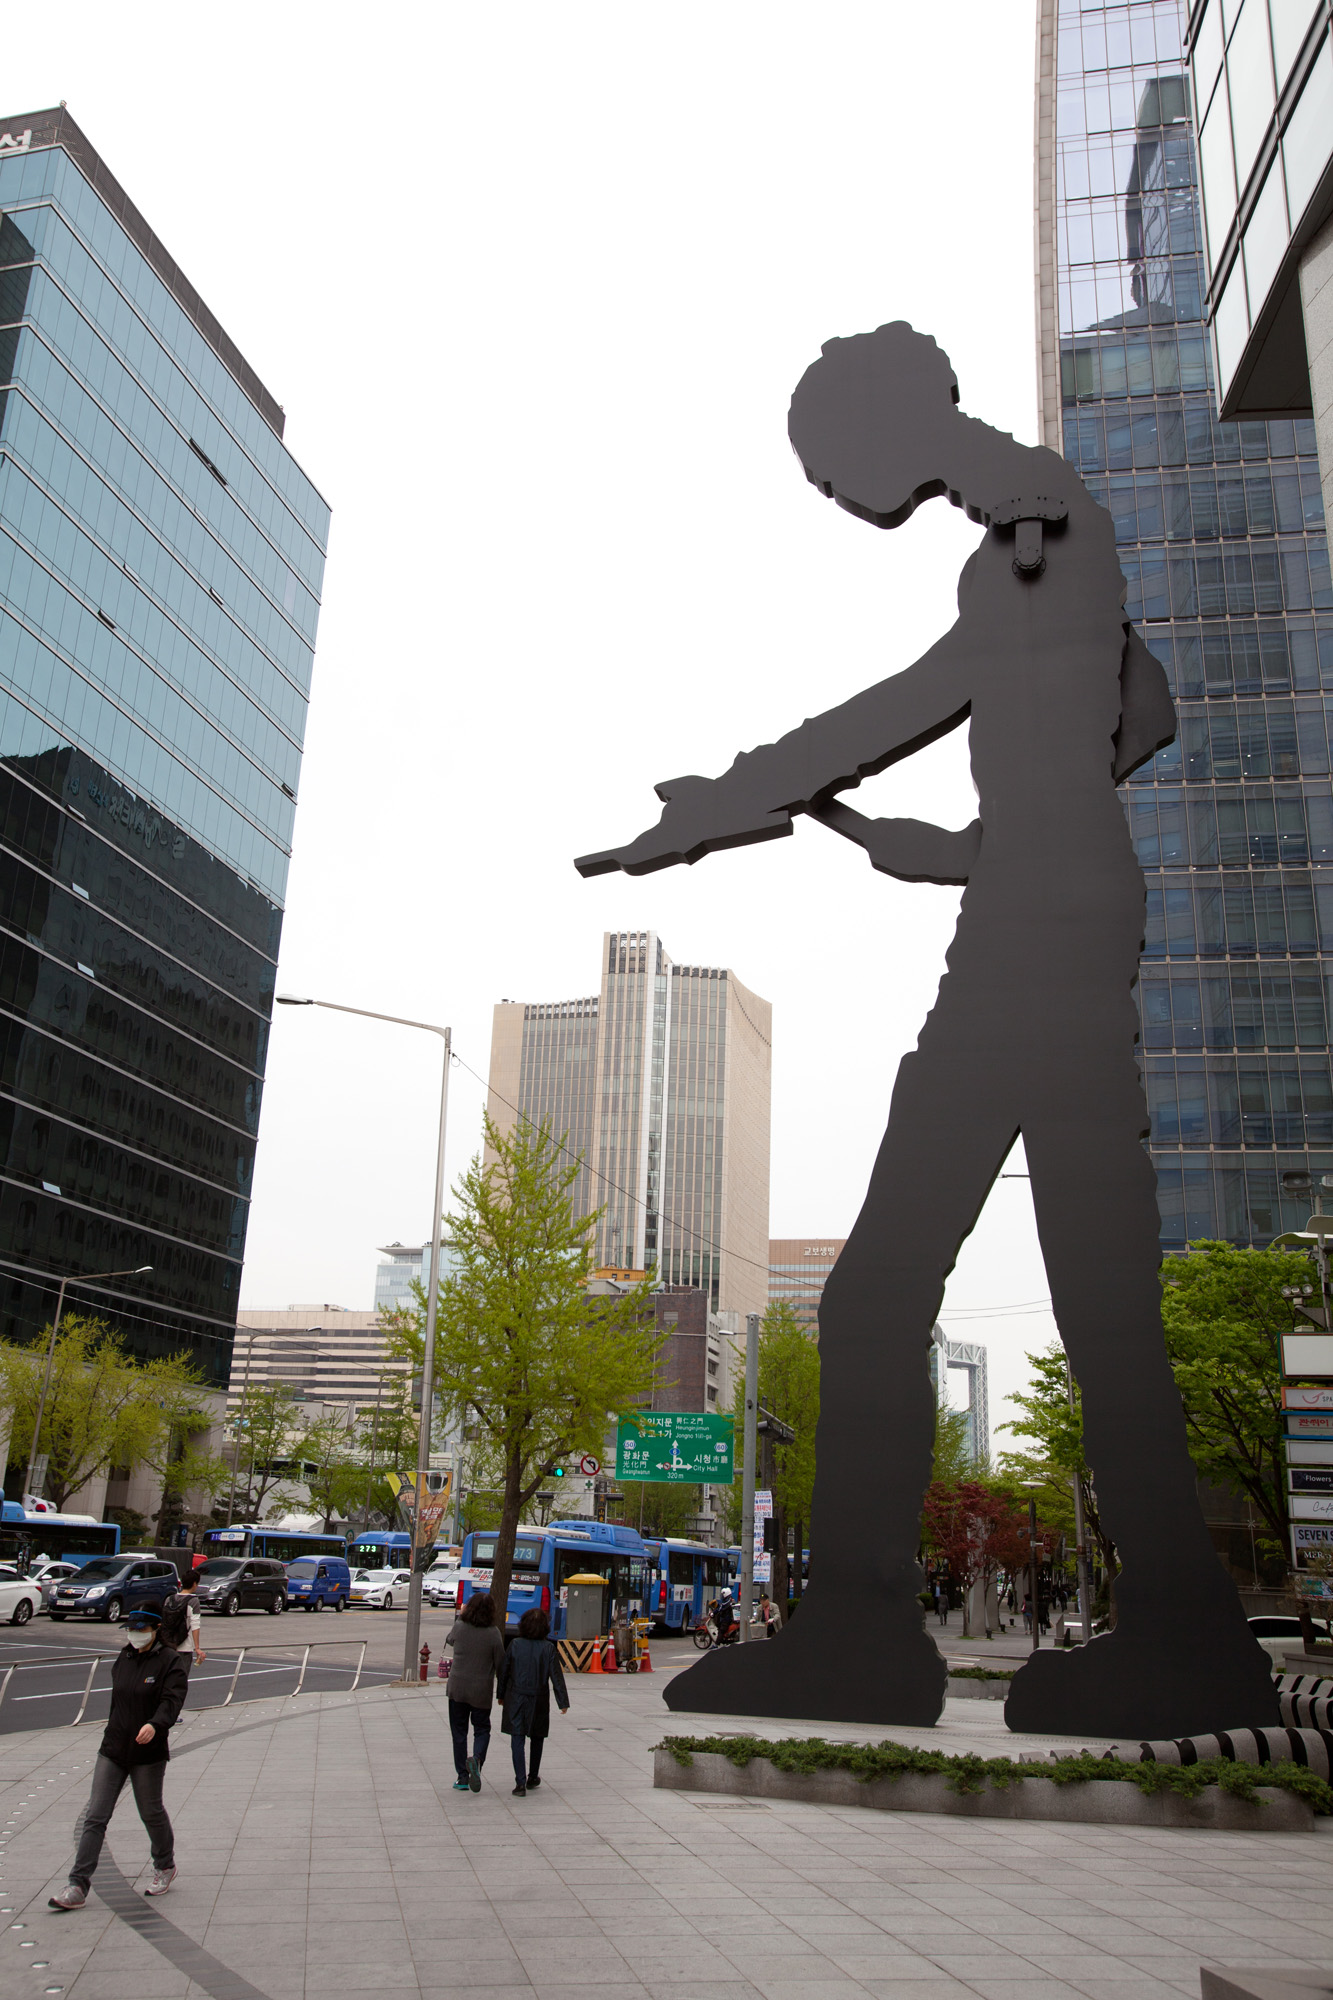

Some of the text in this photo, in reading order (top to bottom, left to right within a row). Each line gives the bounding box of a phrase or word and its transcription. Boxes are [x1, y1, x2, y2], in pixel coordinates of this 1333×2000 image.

[803, 1247, 835, 1256] 교보생명
[675, 1432, 694, 1440] Jongno
[622, 1450, 650, 1461] 광화문
[694, 1454, 711, 1464] 시청
[622, 1461, 647, 1469] 光化門
[1305, 1474, 1332, 1483] Flowers
[1298, 1529, 1329, 1542] SEVEN
[359, 1545, 377, 1553] 273
[513, 1547, 533, 1560] 273
